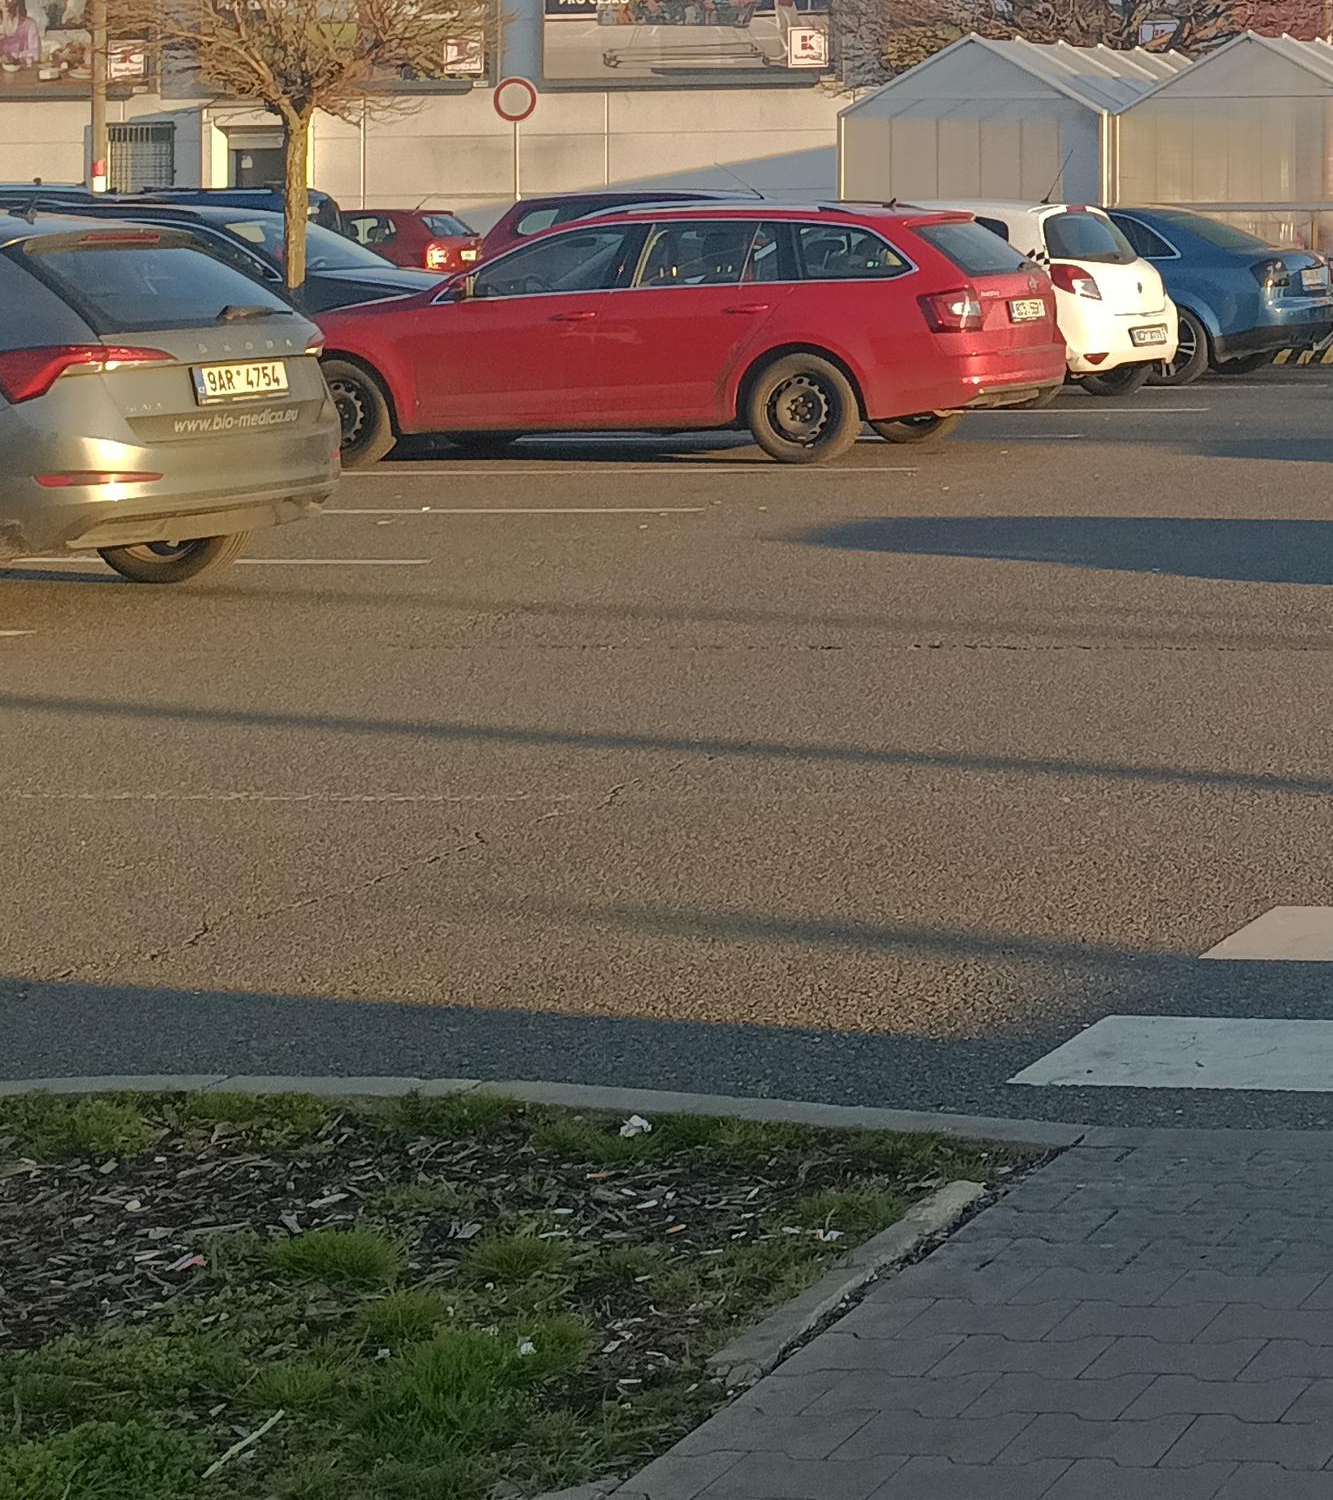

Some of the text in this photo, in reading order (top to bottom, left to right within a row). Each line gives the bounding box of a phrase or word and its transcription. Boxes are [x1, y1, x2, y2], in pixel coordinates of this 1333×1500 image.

[206, 364, 281, 392] 9AR 4754
[173, 407, 299, 433] www.bio-medica.eu
